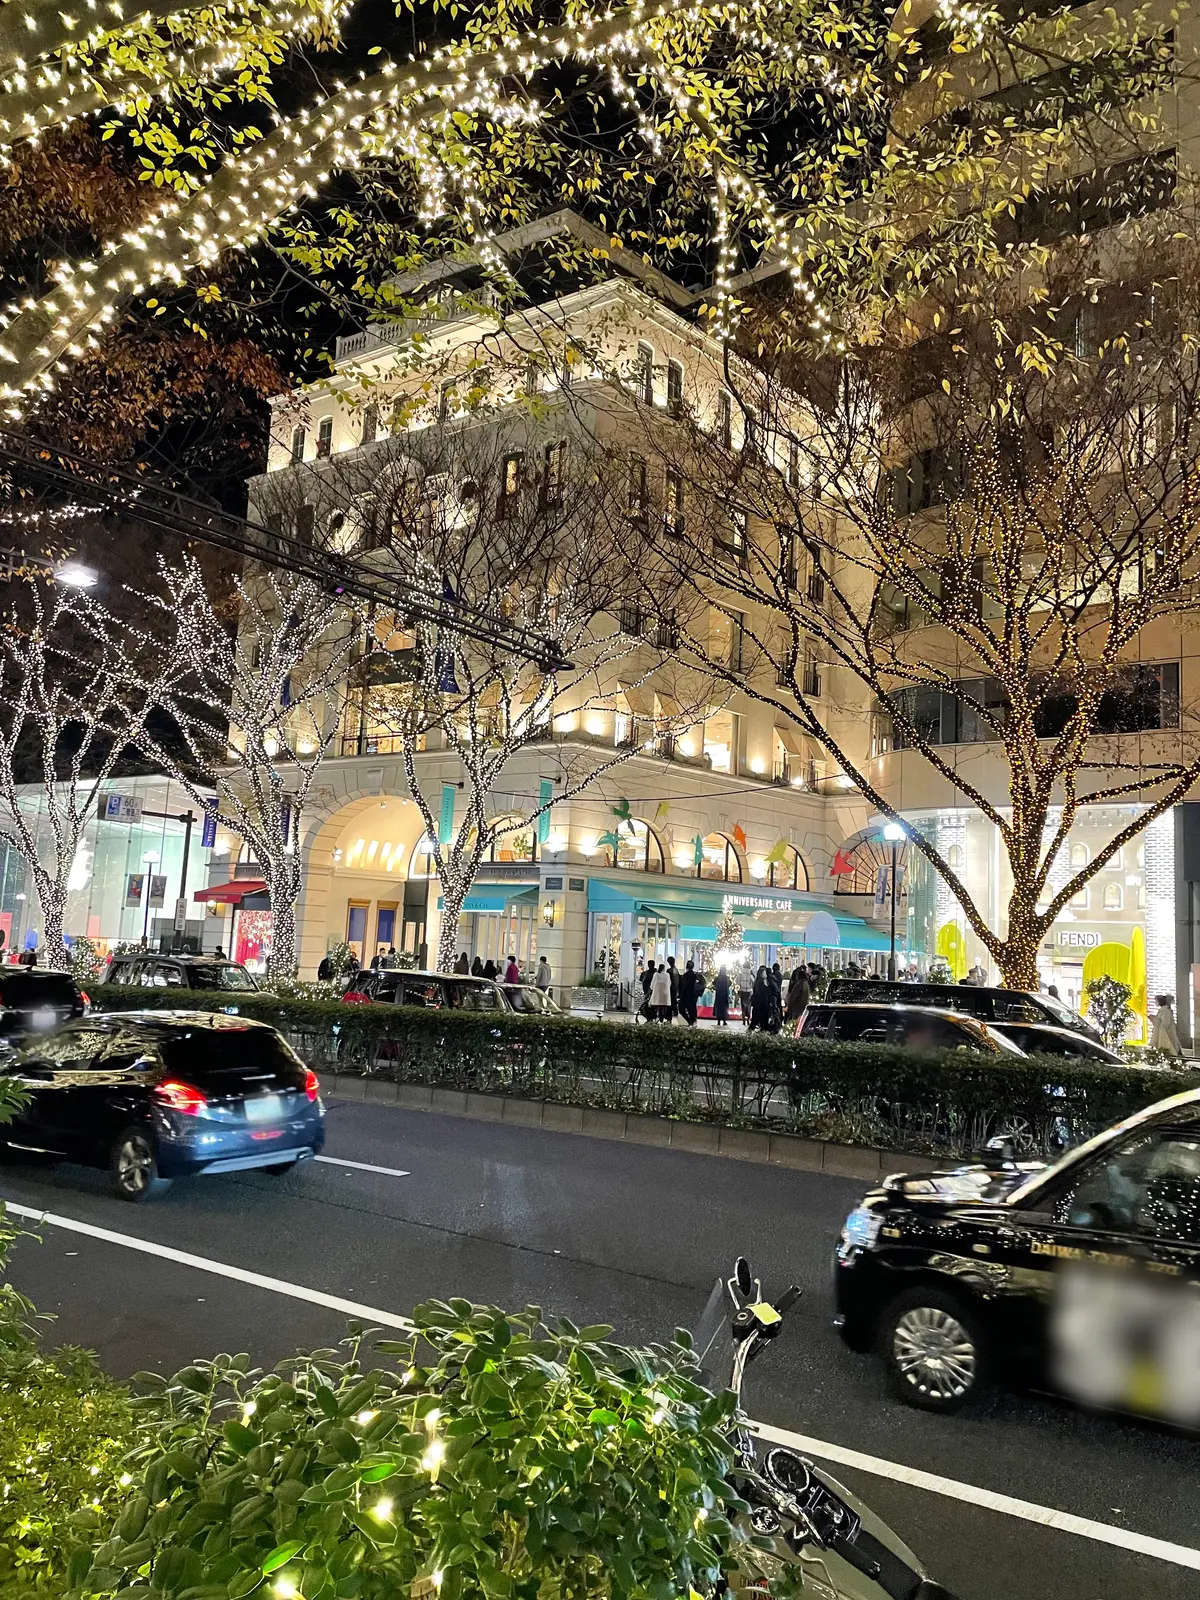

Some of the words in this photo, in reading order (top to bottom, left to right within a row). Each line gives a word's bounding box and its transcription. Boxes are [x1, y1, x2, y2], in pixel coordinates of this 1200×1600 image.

[723, 894, 773, 909] ANNIVERSAIRE
[776, 900, 792, 910] CAFÉ
[1060, 932, 1099, 946] FENDI
